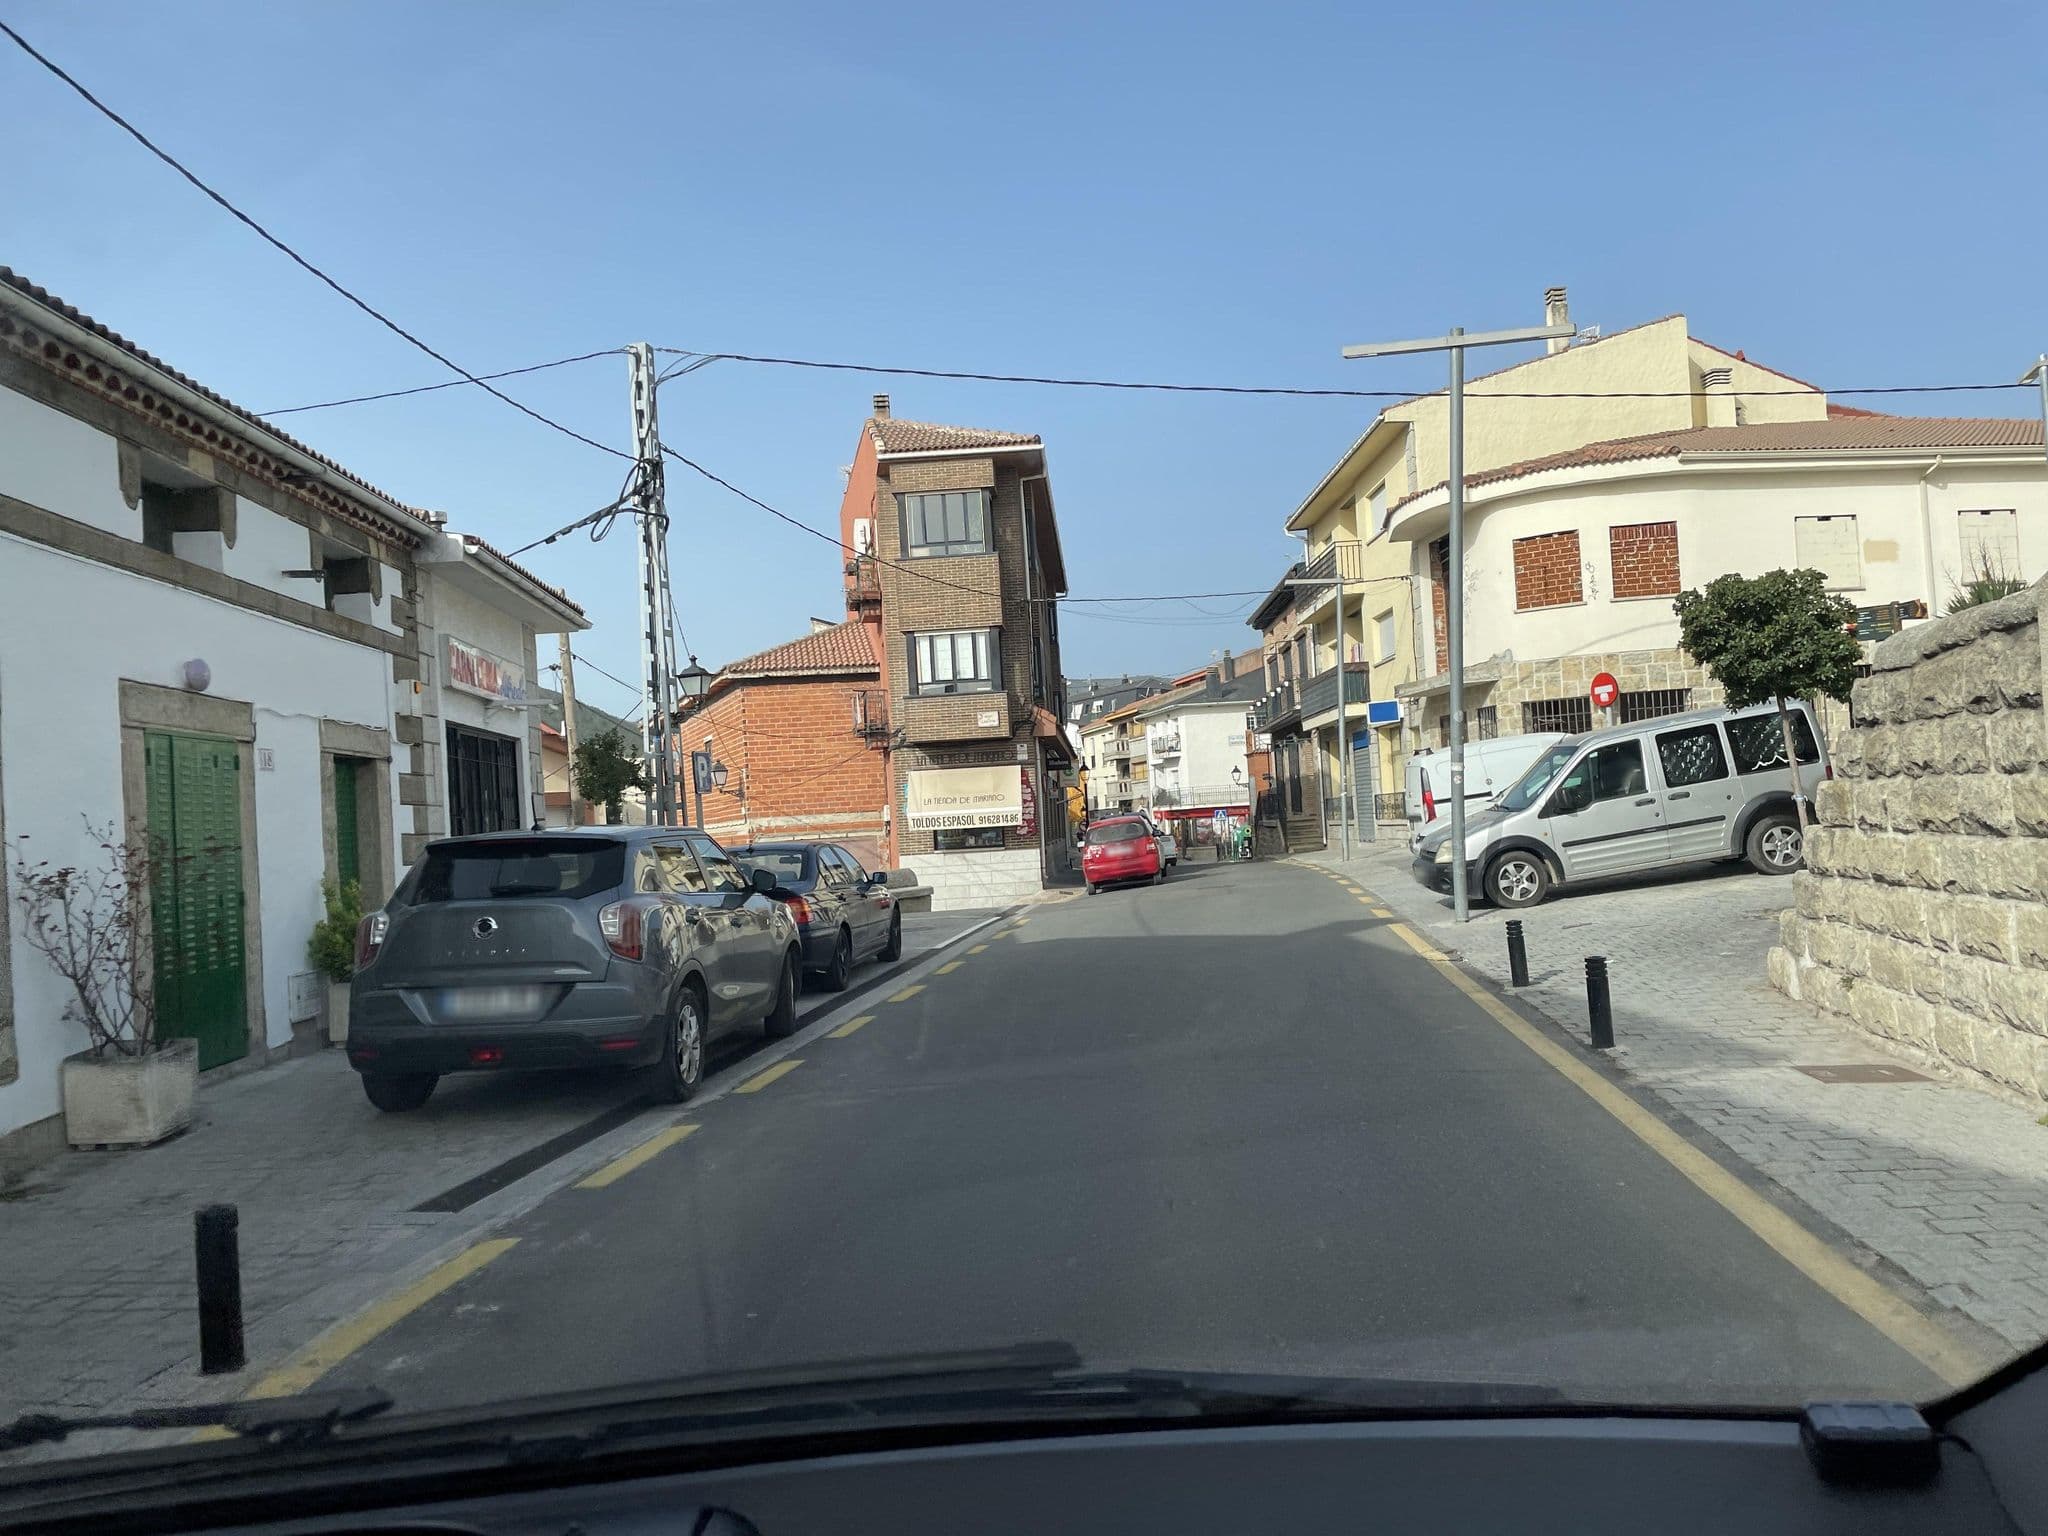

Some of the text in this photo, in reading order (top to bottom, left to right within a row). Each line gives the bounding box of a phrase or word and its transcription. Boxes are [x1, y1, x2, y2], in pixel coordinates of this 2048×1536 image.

[923, 793, 1006, 806] LA TIENDA DE MARIANO
[911, 816, 942, 829] TOLDOS
[942, 814, 977, 828] ESPASOL
